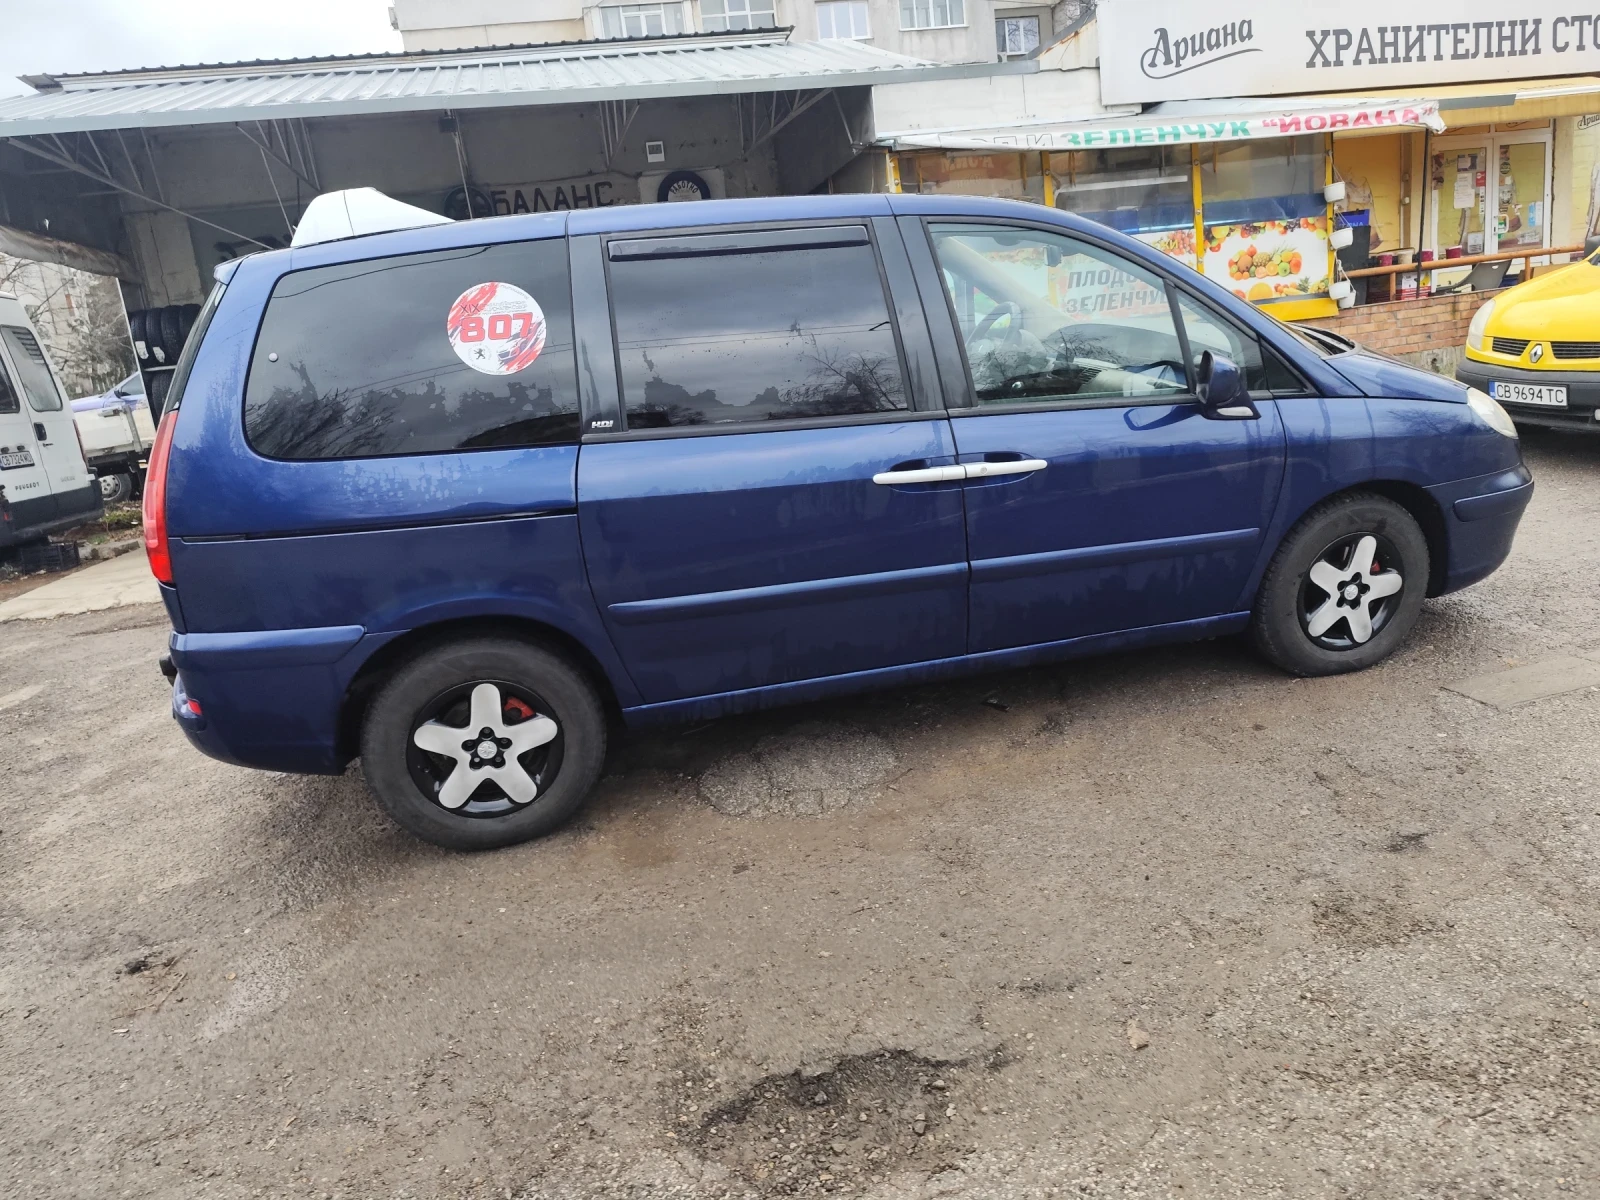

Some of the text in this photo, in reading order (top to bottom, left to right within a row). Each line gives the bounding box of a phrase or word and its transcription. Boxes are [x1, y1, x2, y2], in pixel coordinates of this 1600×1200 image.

[1141, 19, 1258, 76] Ариана
[1305, 18, 1542, 69] ХРАНИТЕЛНИ
[1060, 120, 1251, 146] ЗЕЛЕНЧУК
[490, 181, 613, 216] БАЛАНС
[460, 303, 480, 314] XIX
[460, 312, 534, 343] 807
[15, 482, 40, 491] PEUGEOT
